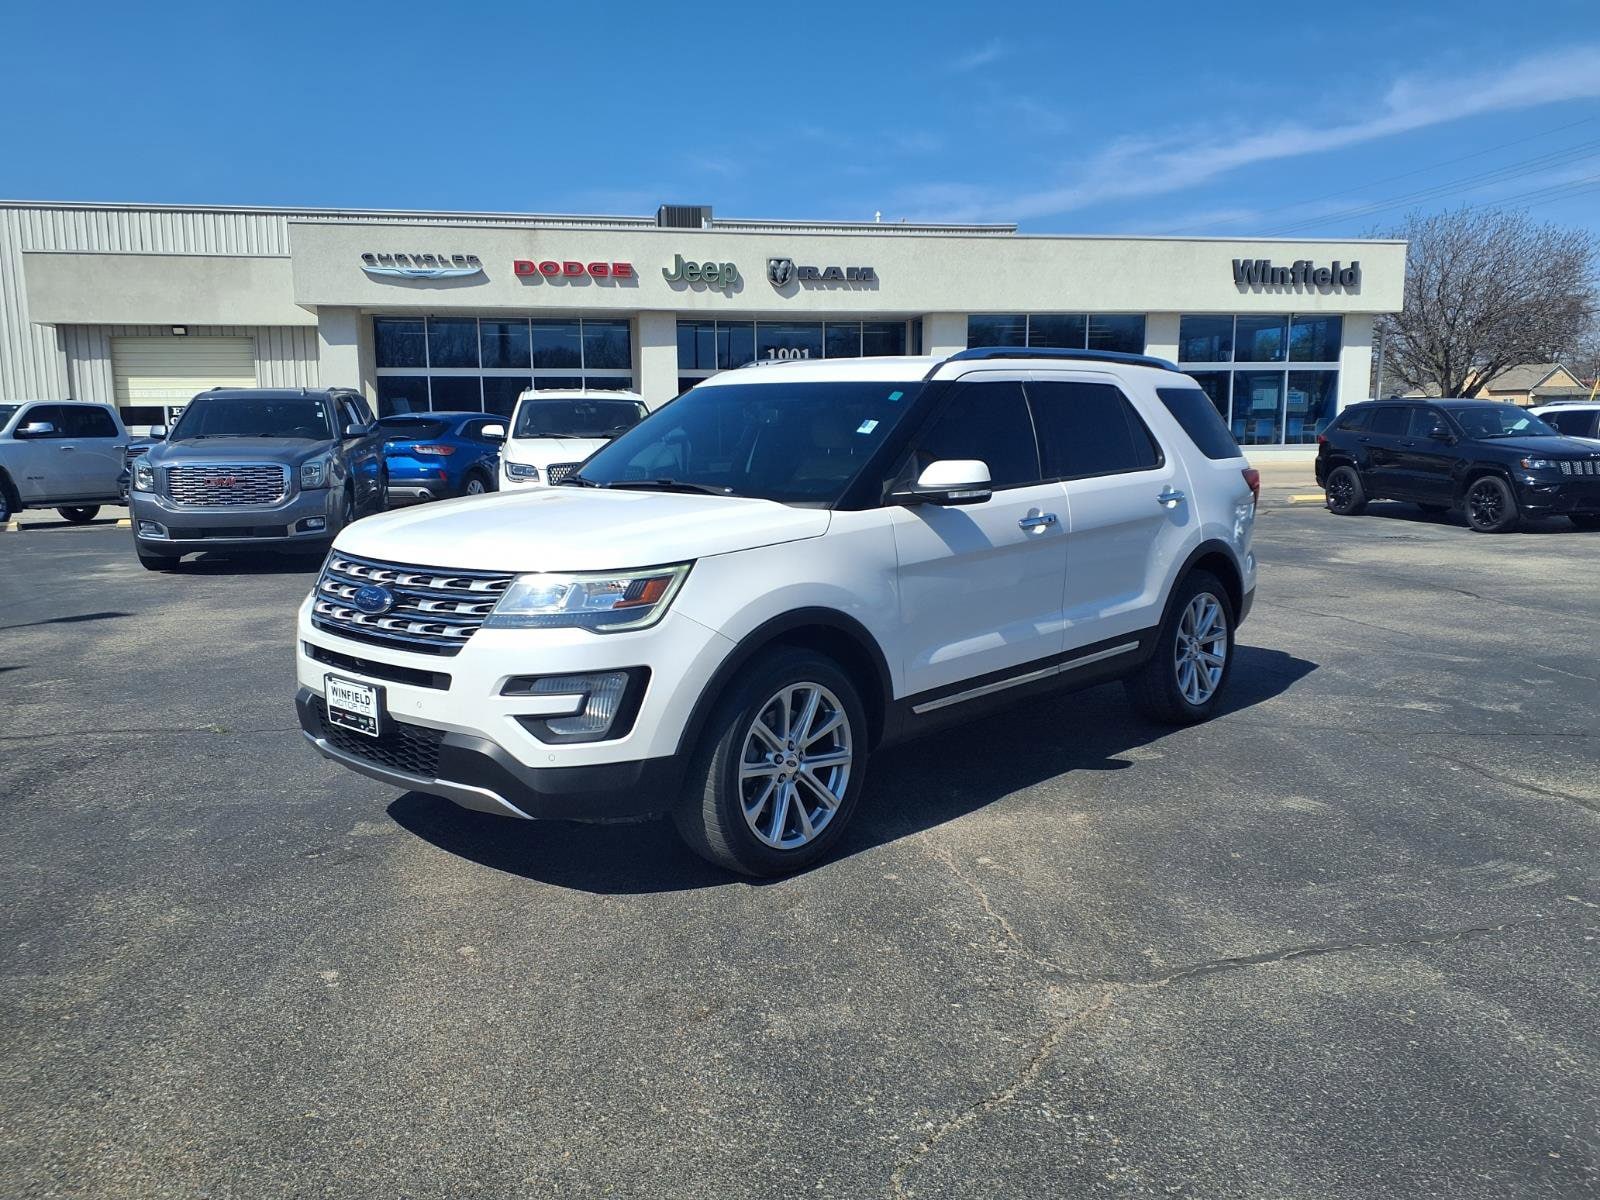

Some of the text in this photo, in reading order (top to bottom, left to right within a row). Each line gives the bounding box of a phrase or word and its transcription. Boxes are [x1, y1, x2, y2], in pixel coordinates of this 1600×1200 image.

[361, 252, 480, 264] CHRYSLER
[513, 260, 632, 277] DODGE
[662, 254, 738, 287] Jeep
[798, 266, 874, 280] RAM
[1232, 259, 1362, 286] Winfield
[767, 348, 809, 360] 1001
[331, 686, 370, 705] WINFIELD
